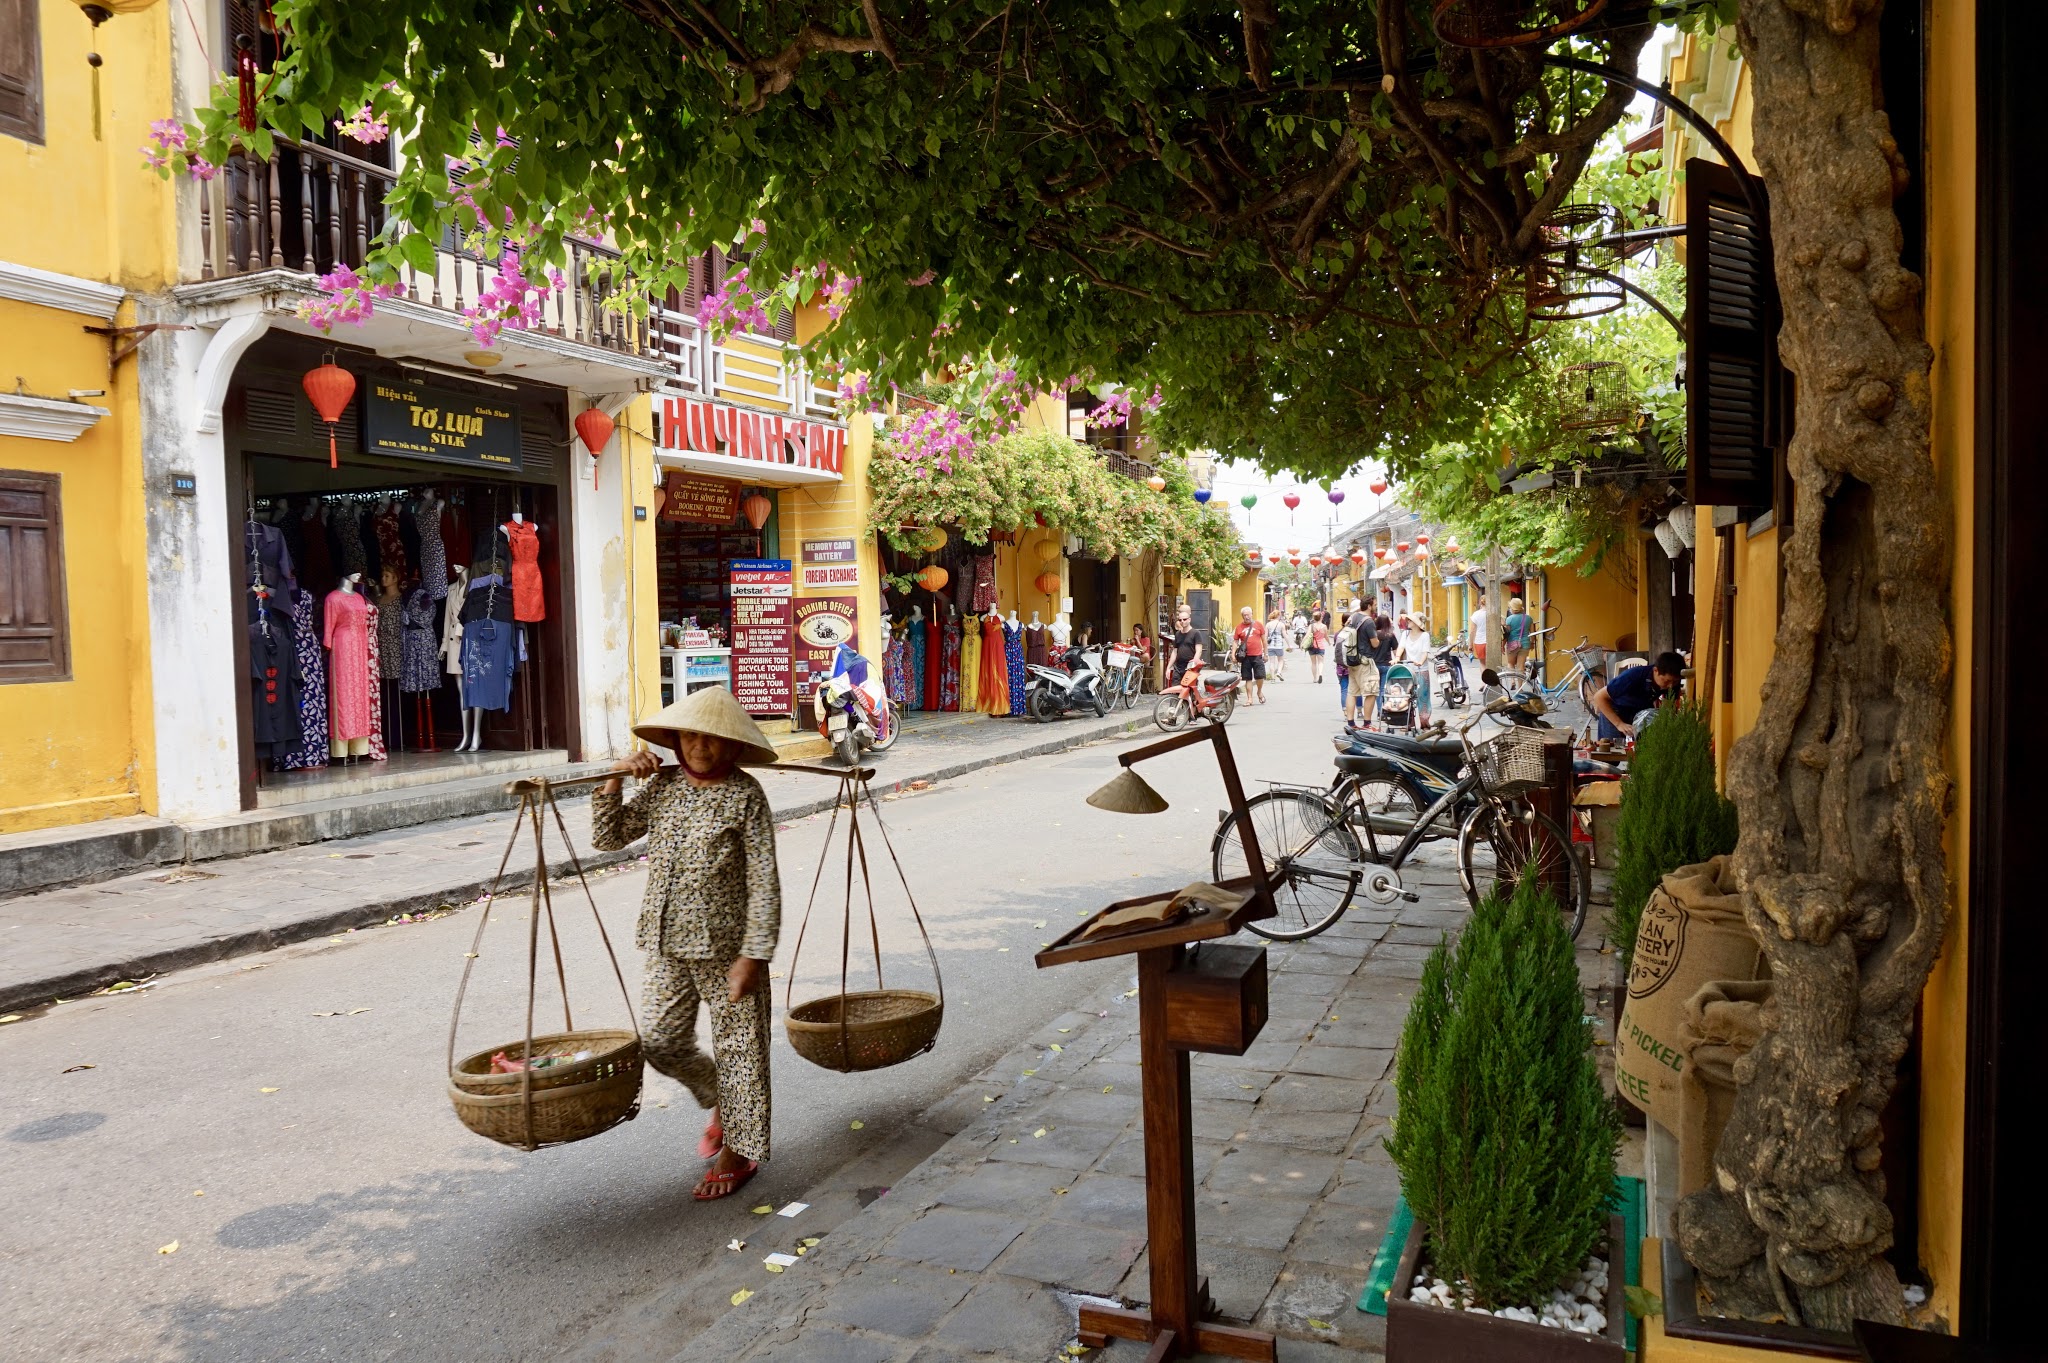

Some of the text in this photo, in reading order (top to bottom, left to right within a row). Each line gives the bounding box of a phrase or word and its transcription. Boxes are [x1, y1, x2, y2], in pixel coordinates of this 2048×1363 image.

[494, 410, 510, 418] Shop
[431, 432, 466, 448] SILK
[678, 503, 725, 513] BOOKING OFFICE
[805, 541, 851, 551] MEMORY CARD
[814, 552, 842, 560] BATTERY
[805, 568, 857, 583] FOREIGN EXCHANGE
[733, 586, 763, 594] Jetstar
[796, 601, 854, 618] BOOKING OFFICE
[736, 632, 744, 640] HA
[809, 650, 829, 660] EASY
[1645, 920, 1665, 939] AN
[1649, 957, 1669, 967] HOUSE
[1630, 1024, 1684, 1072] PICKED
